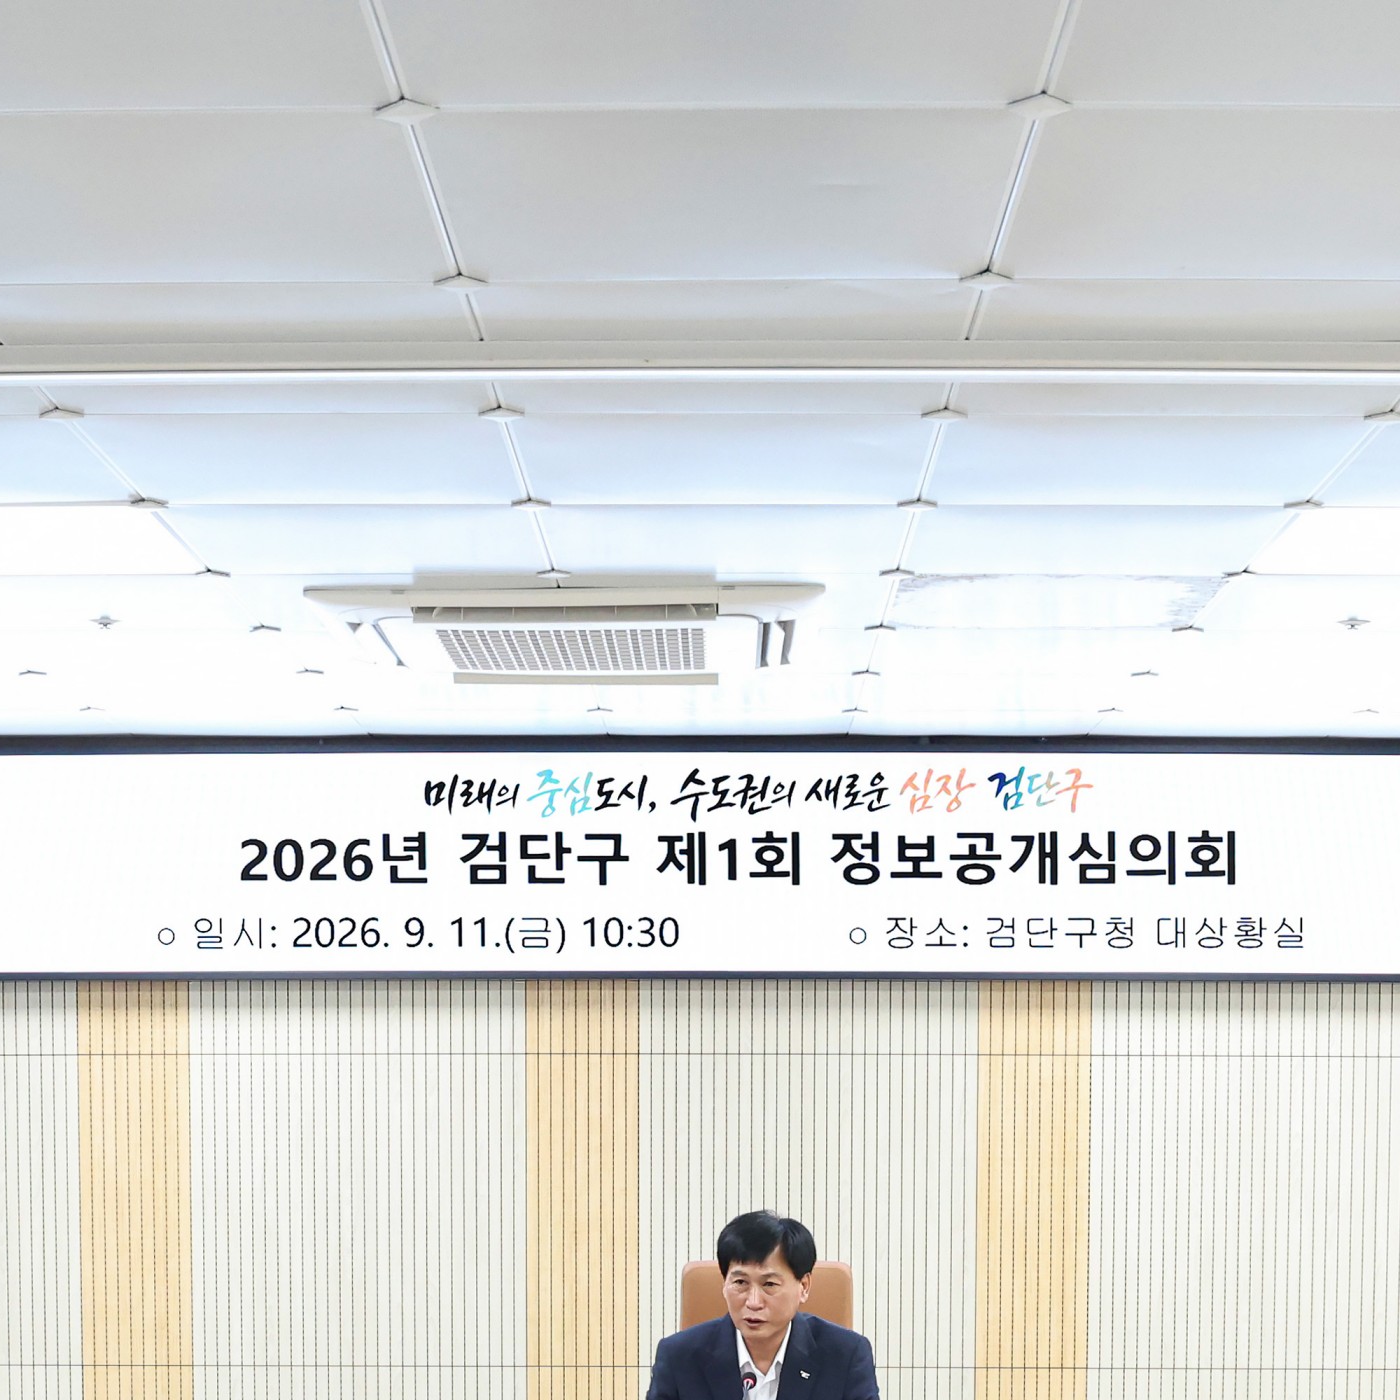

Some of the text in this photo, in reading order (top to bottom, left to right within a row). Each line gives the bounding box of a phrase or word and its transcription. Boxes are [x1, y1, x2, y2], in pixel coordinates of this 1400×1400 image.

[424, 765, 1095, 822] 미래의 중심도시, 수도권의 새로운 심장 검단구
[240, 829, 1236, 887] 2026년 검단구 제1회 정보공개심의회
[193, 916, 680, 955] 일시: 2026. 9. 11.(금) 10:30
[885, 916, 1304, 950] 장소: 검단구청 대상황실
